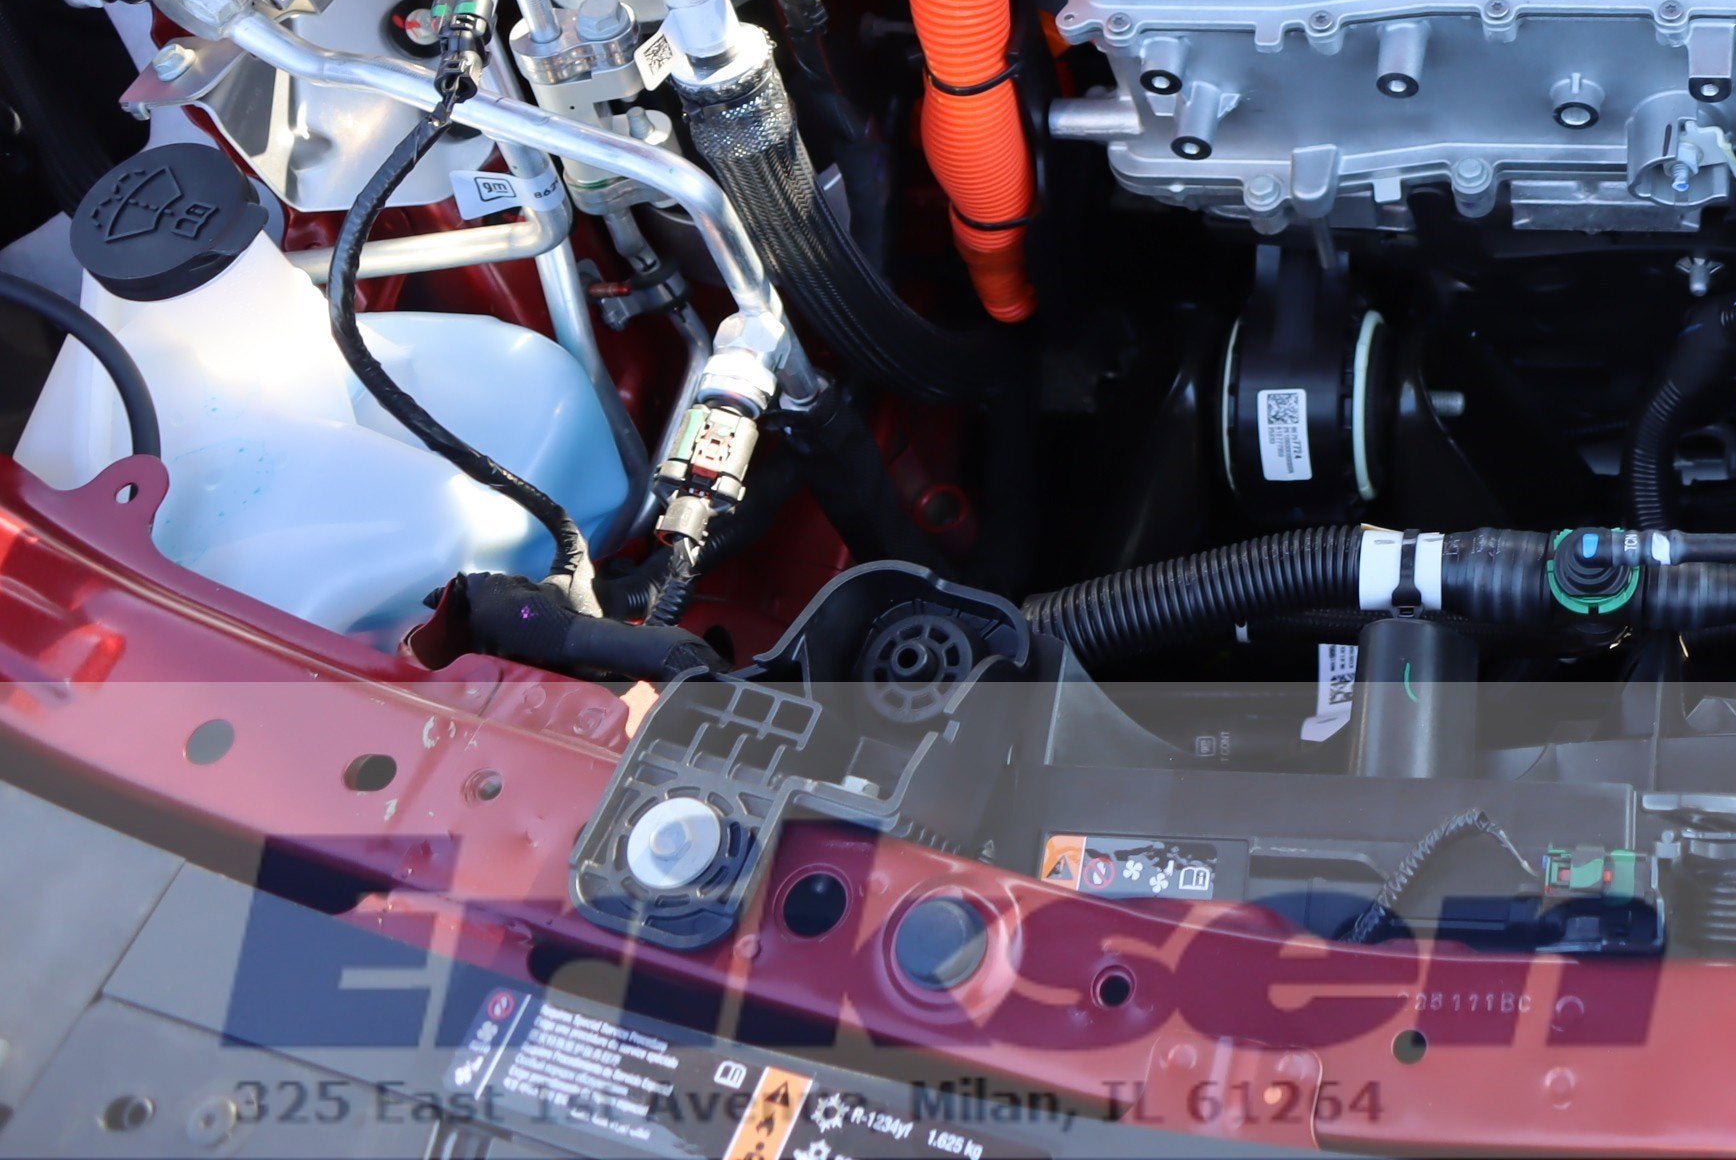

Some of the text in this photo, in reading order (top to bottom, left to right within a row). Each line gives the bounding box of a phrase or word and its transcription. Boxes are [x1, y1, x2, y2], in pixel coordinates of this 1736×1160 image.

[1624, 533, 1638, 552] TCN
[928, 1128, 963, 1155] 1.625
[963, 1137, 984, 1159] kg
